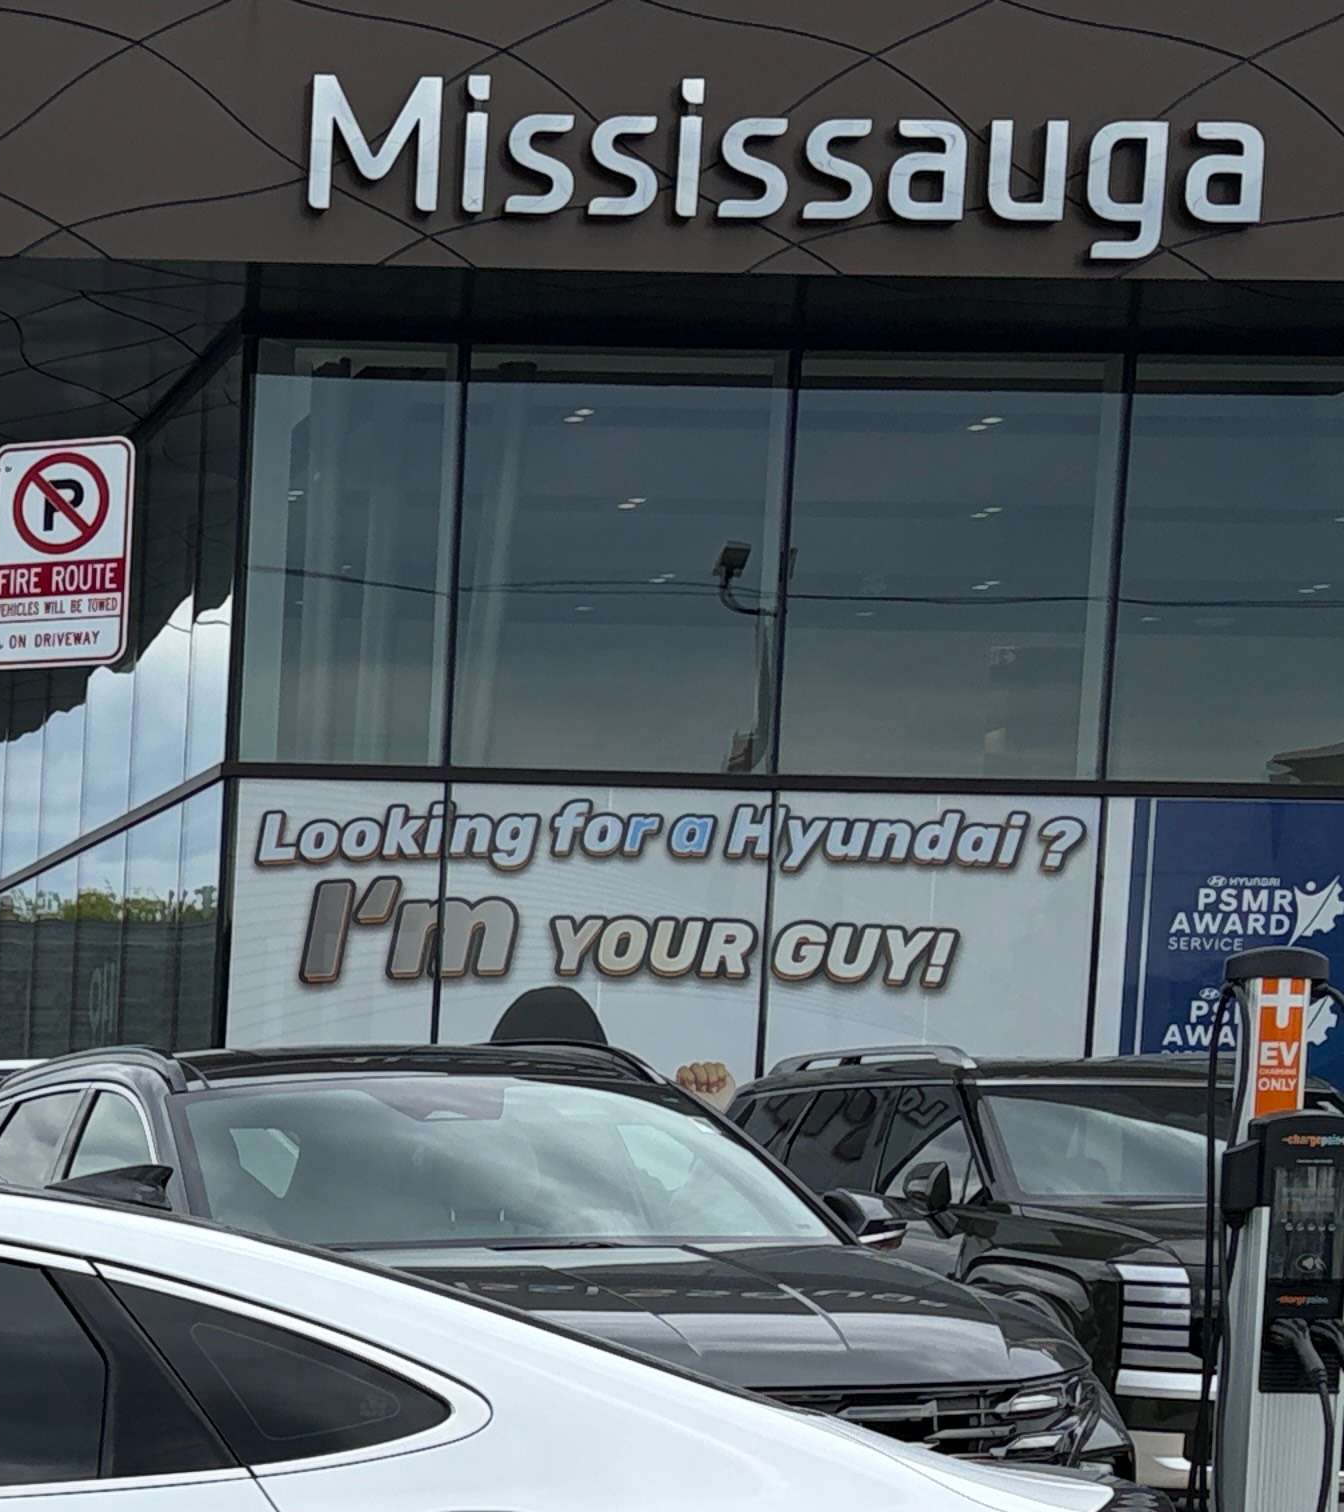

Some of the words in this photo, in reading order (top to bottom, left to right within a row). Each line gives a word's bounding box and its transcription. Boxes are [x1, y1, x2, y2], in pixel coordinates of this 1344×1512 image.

[307, 74, 1266, 260] Mississauga
[51, 562, 118, 593] ROUTE
[43, 600, 65, 615] WILL
[70, 599, 82, 613] BE
[87, 597, 118, 613] TOWED
[8, 634, 26, 649] ON
[34, 630, 100, 648] DRIVEWAY
[254, 803, 544, 871] Looking
[549, 799, 662, 857] for
[667, 814, 716, 857] a
[724, 804, 1031, 872] Hyundai
[1038, 817, 1088, 872] ?
[1229, 876, 1280, 887] HYUNDAI
[1197, 887, 1293, 912] PSMR
[298, 874, 521, 985] I'm
[548, 914, 758, 985] YOUR
[769, 920, 963, 989] GUY!
[1169, 912, 1290, 936] AWARD
[1167, 936, 1243, 951] SERVICE
[1259, 1041, 1299, 1066] EV
[1257, 1077, 1297, 1091] ONLY
